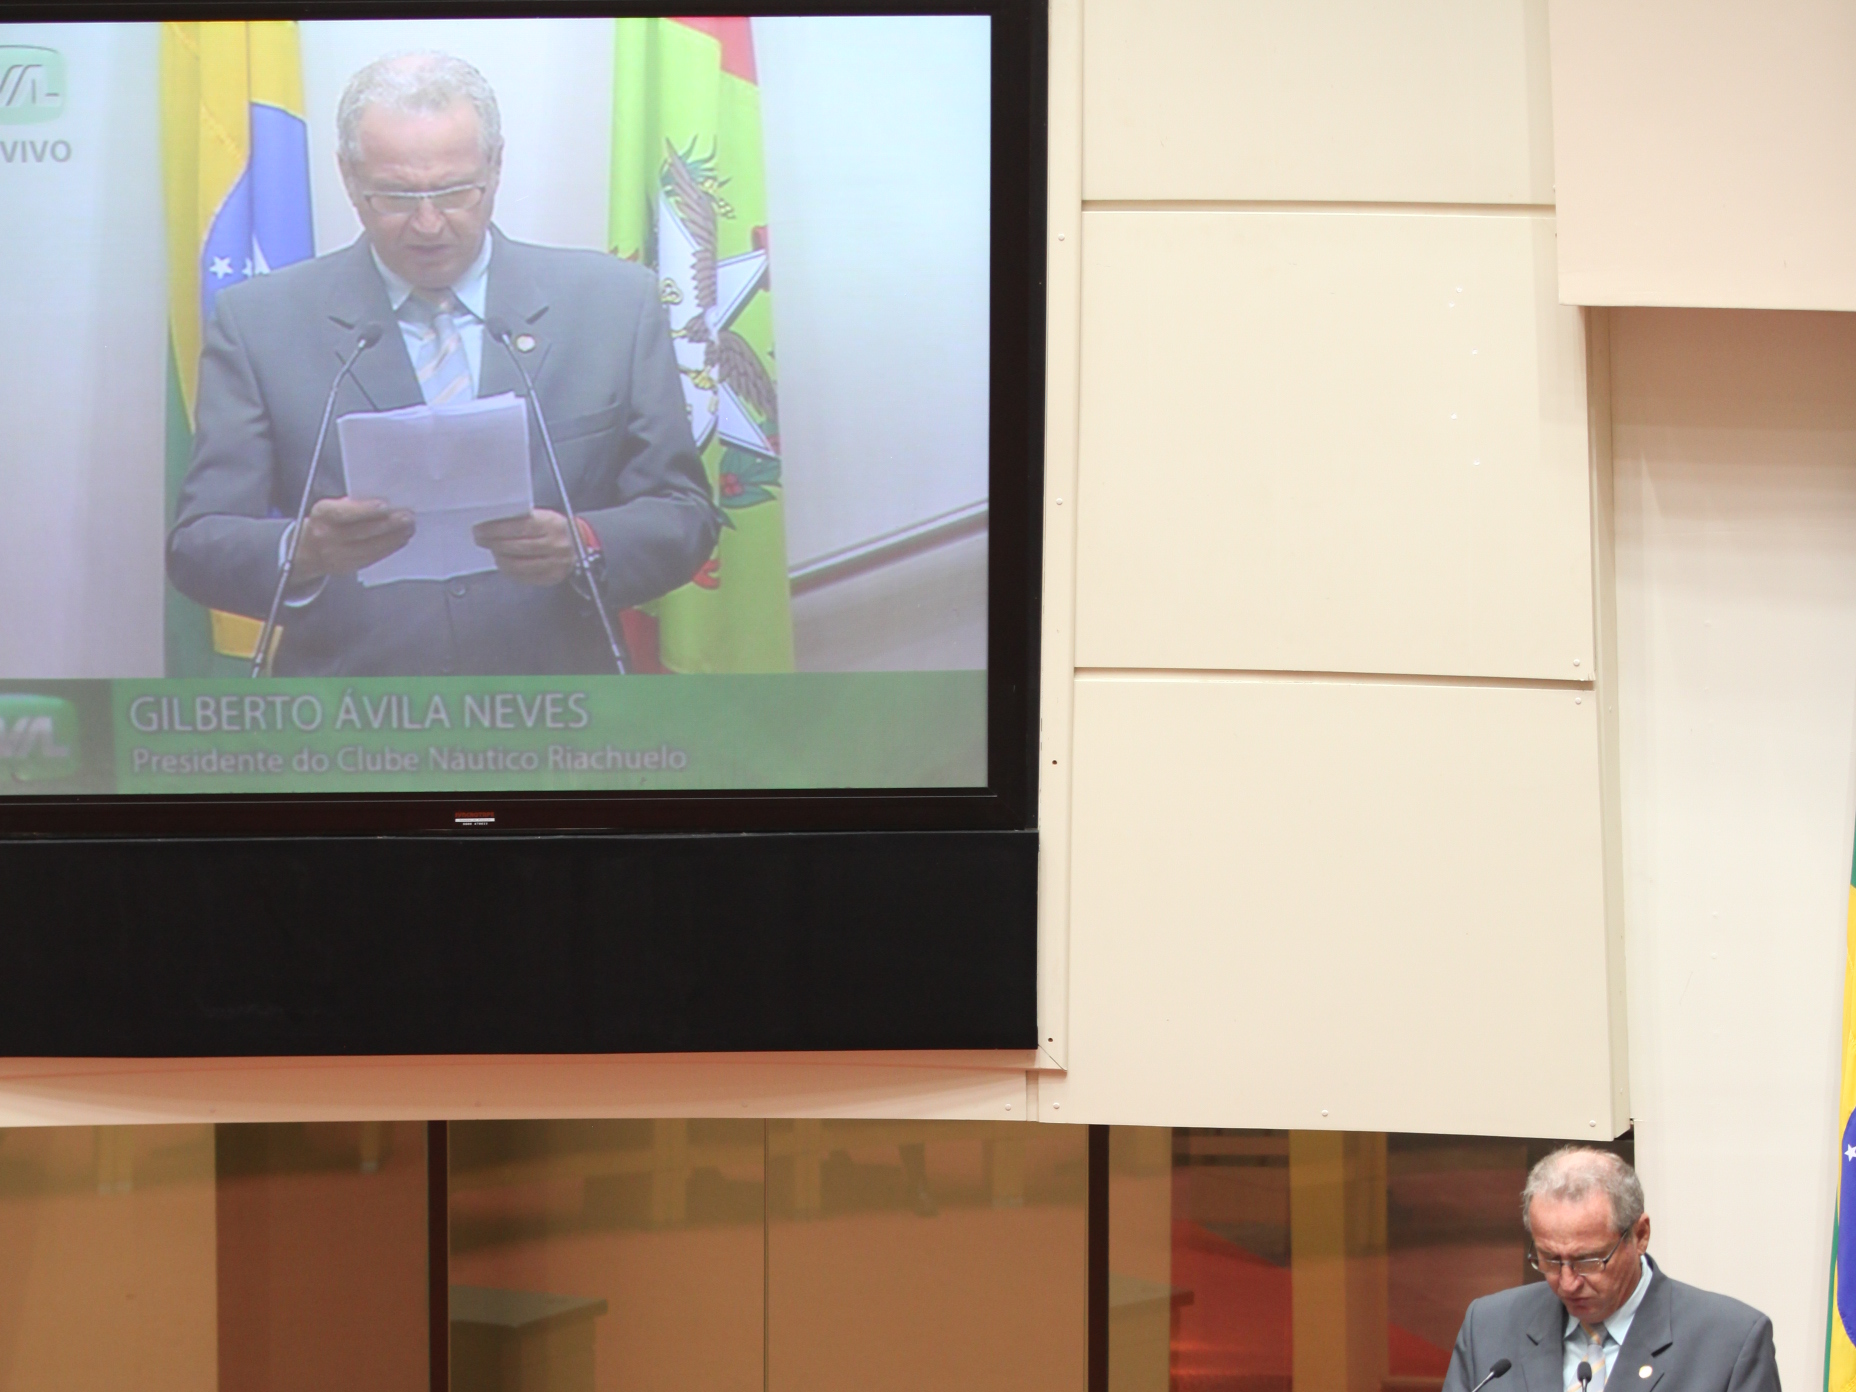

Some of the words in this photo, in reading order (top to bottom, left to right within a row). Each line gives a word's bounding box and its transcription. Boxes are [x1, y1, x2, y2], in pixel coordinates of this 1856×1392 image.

[130, 695, 323, 731] GILBERTO
[335, 688, 450, 730] ÁVILA
[464, 692, 589, 729] NEVES
[133, 748, 284, 773] Presidente
[292, 748, 329, 773] do
[337, 746, 419, 772] Clube
[549, 744, 688, 771] Riachuelo
